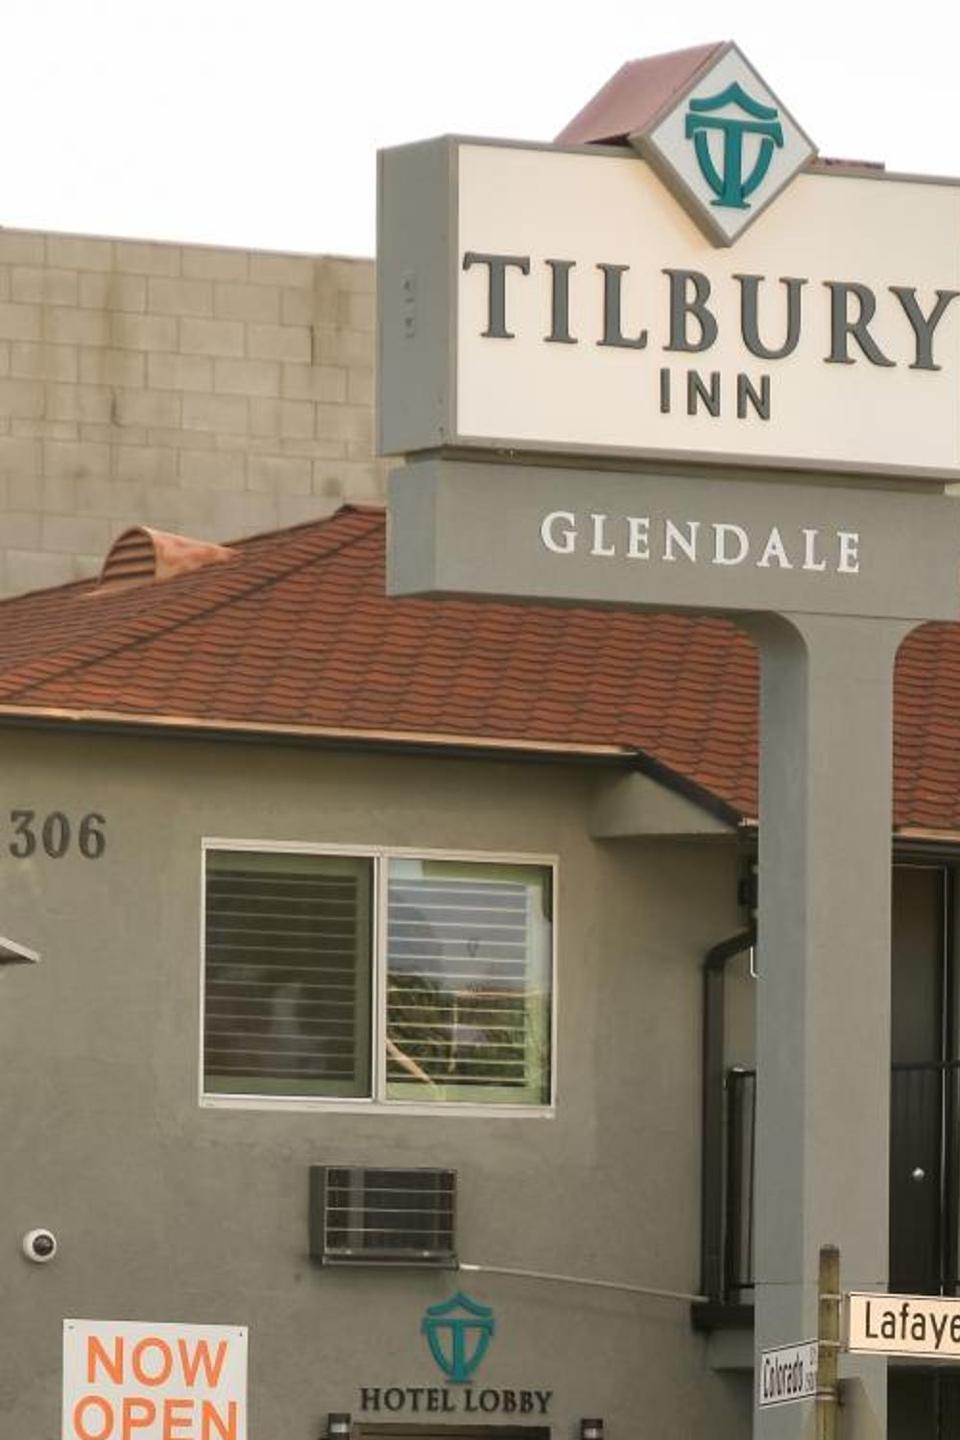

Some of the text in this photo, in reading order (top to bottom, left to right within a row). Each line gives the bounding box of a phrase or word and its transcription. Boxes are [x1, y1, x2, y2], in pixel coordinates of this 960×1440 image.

[462, 251, 960, 371] TILBURY
[660, 368, 771, 420] INN
[540, 510, 861, 574] GLENDALE
[9, 810, 107, 859] 306
[86, 1335, 228, 1388] NOW
[361, 1387, 553, 1414] HOTEL LOBBY
